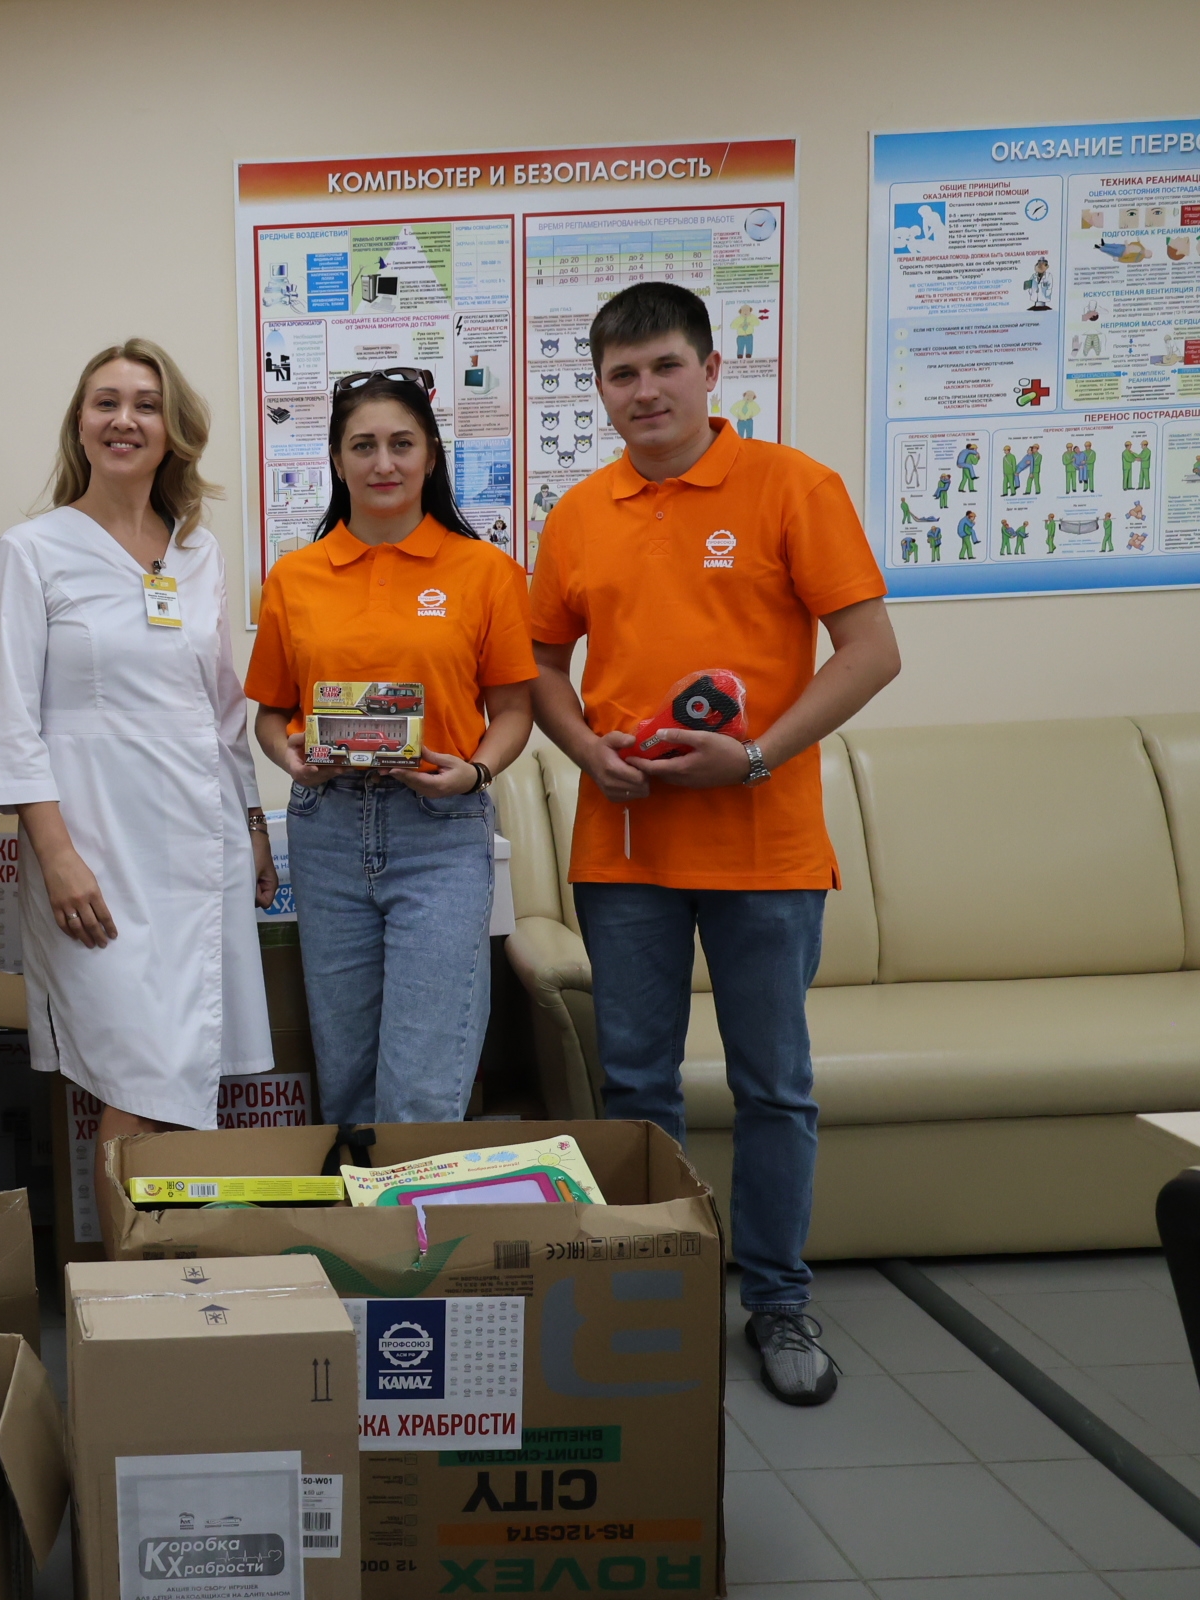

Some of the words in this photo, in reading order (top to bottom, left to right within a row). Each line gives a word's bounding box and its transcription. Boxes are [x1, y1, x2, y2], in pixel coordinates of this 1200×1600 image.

[991, 136, 1123, 162] ОКАЗАНИЕ
[328, 167, 482, 193] КОМПЬЮТЕР
[489, 166, 505, 186] И
[513, 158, 712, 184] БЕЗОПАСНОСТЬ
[1100, 177, 1143, 187] ТЕХНИКА
[1146, 174, 1200, 184] РЕАНИМАЦ
[969, 182, 1011, 190] ПРИНЦИПЫ
[1089, 189, 1116, 197] ОЦЕНКА
[539, 222, 564, 231] ВРЕМЯ
[565, 219, 652, 230] РЕГЛАМЕНТИРОВАННЫХ
[654, 217, 698, 226] ПЕРЕРЫВОВ
[707, 215, 734, 224] РАБОТЕ
[260, 232, 294, 240] ВРЕДНЫЕ
[296, 230, 348, 239] ВОЗДЕЙСТВИЯ
[1102, 228, 1149, 238] ПОДГОТОВКА
[1083, 289, 1144, 298] ИСКУССТВЕННАЯ
[331, 317, 370, 325] СОБЛЮДАЙТЕ
[372, 315, 412, 324] БЕЗОПАСНОЕ
[414, 314, 450, 322] РАССТОЯНИЕ
[1084, 412, 1130, 422] ПЕРЕНОС
[704, 560, 734, 568] KAMAZ
[418, 610, 446, 618] KAMAZ
[220, 1080, 306, 1109] ОРОБКА
[218, 1110, 306, 1128] РАБРОСТИ
[349, 1174, 399, 1183] ИГРУШКА
[379, 1376, 432, 1389] KAMAZ
[397, 1413, 516, 1436] ХРАБРОСТИ
[522, 1429, 603, 1443] ВНЕШНИ
[457, 1448, 603, 1462] СПЛИТ-СИСТЕМА
[462, 1469, 597, 1512] CITY
[507, 1523, 634, 1541] RS-12CST4
[144, 1537, 240, 1572] Коробка
[165, 1555, 264, 1578] Храбрости
[439, 1554, 702, 1594] ROVEX
